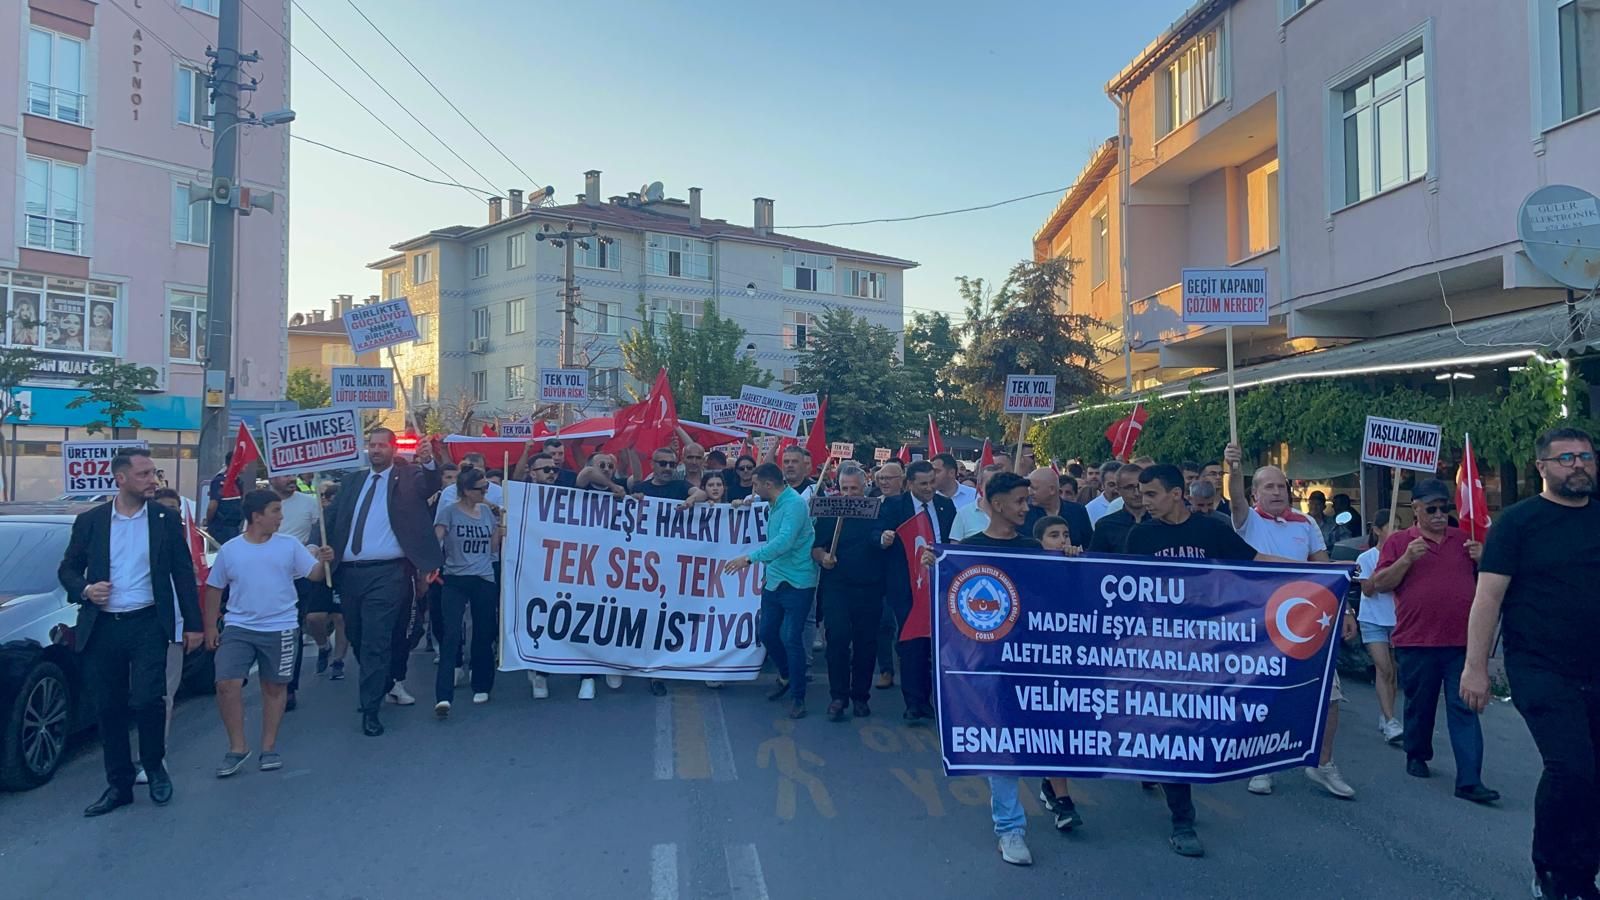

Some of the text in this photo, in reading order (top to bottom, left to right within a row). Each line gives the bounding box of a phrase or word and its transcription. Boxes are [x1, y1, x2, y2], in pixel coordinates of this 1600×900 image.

[1188, 276, 1264, 296] GEÇİT KAPANDI
[352, 302, 401, 322] BİRLİKTE
[1186, 296, 1264, 316] ÇÖZÜM NEREDE?
[340, 374, 354, 387] YOL
[544, 374, 562, 386] TEK
[1012, 381, 1030, 393] TEK
[336, 388, 357, 402] LÜTUF
[544, 386, 584, 398] BÜYÜK RİSK!
[741, 392, 761, 404] HAREKET
[761, 395, 783, 409] OLMAYAN
[1009, 394, 1052, 408] BÜYÜK RİSK!
[736, 404, 796, 432] BEREKET OLMAZ
[278, 416, 346, 444] VELİMEŞE
[1371, 424, 1438, 447] YAŞLILARIMIZI
[68, 446, 108, 459] ÜRETEN
[276, 438, 355, 466] İZOLE EDİLEMEZ!
[1368, 442, 1435, 465] UNUTMAYIN!
[69, 459, 110, 478] ÇÖZ
[656, 502, 721, 543] HALKI
[463, 540, 488, 553] OUT
[542, 539, 600, 586] TEK
[606, 547, 666, 599] SES,
[677, 554, 725, 598] TEK
[1100, 574, 1186, 607] ÇORLU
[526, 592, 648, 650] ÇÖZÜM
[1028, 610, 1256, 643] MADENİ EŞYA ELEKTRİKLİ
[1001, 642, 1287, 677] ALETLER SANATKARLARI ODASI
[1015, 680, 1269, 723] VELİMEŞE HALKININ ve
[952, 726, 1064, 754] ESNAFININ
[1069, 729, 1111, 756] HER
[1118, 732, 1204, 761] ZAMAN
[1211, 730, 1303, 762] YANINDA...
